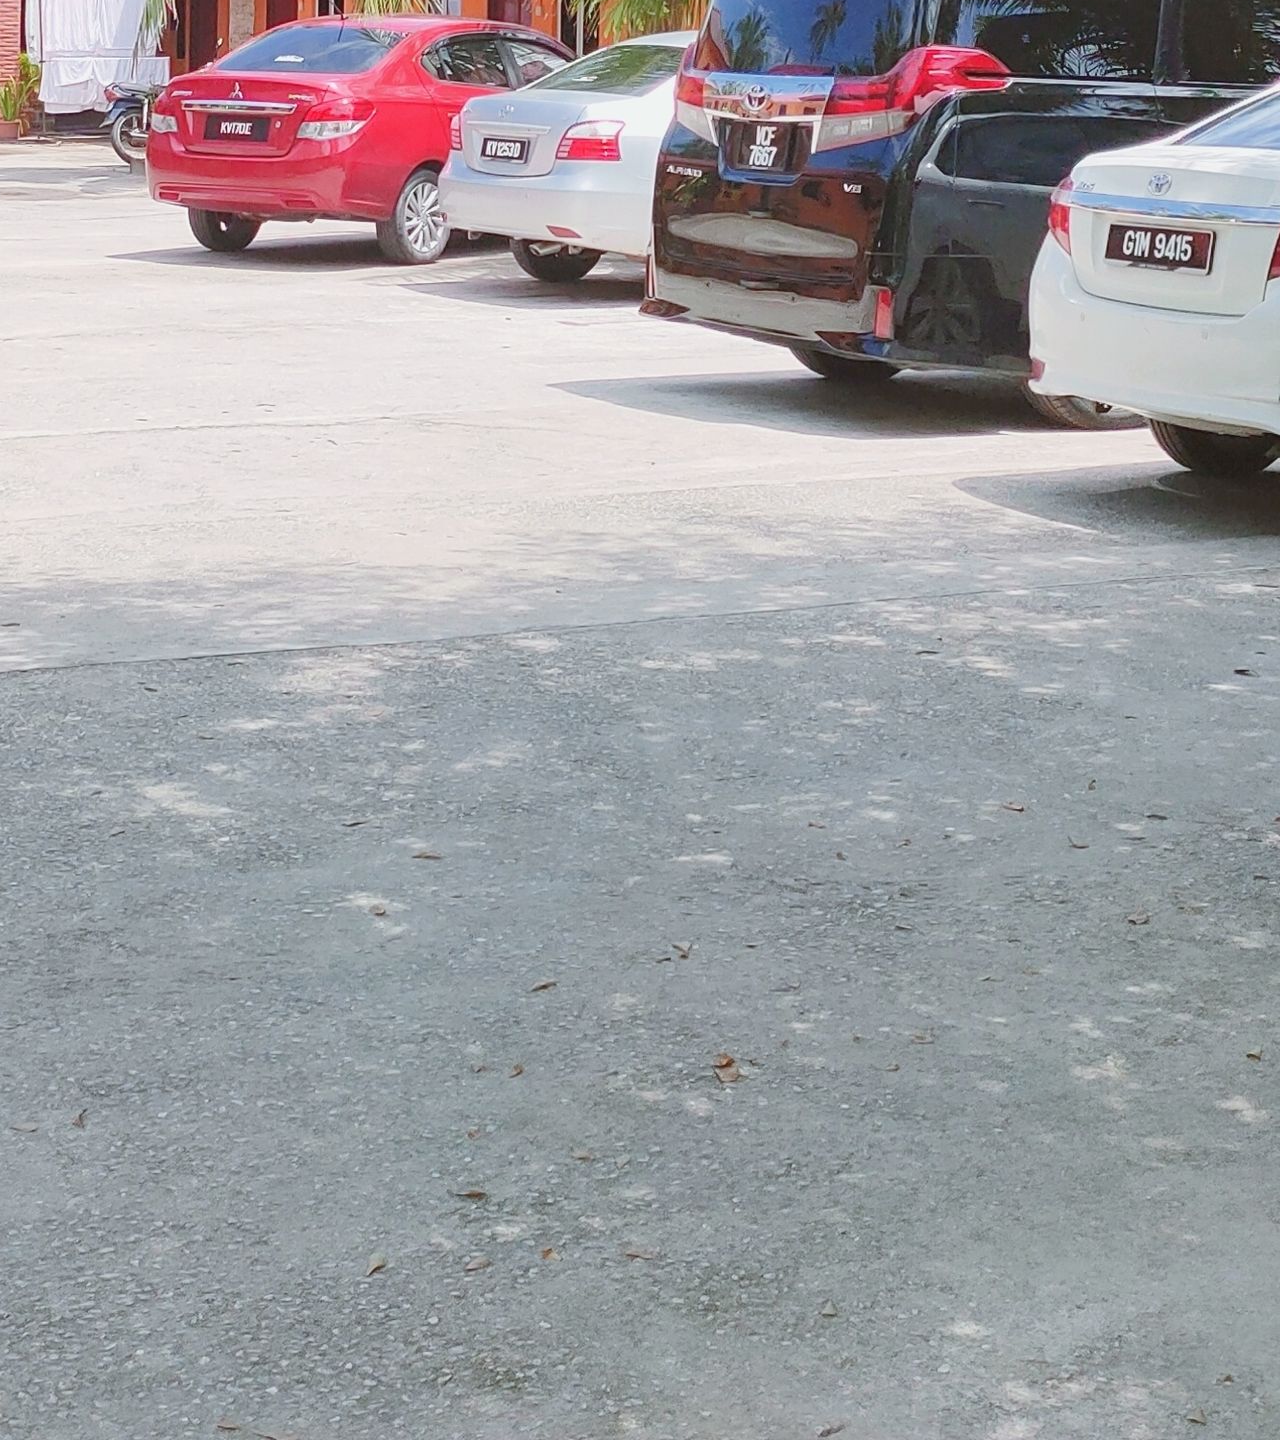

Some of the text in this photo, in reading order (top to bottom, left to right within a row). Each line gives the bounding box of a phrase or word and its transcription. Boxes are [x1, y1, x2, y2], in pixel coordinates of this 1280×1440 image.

[755, 125, 777, 147] VCF
[748, 145, 778, 167] 7667
[1153, 232, 1194, 262] 9415
